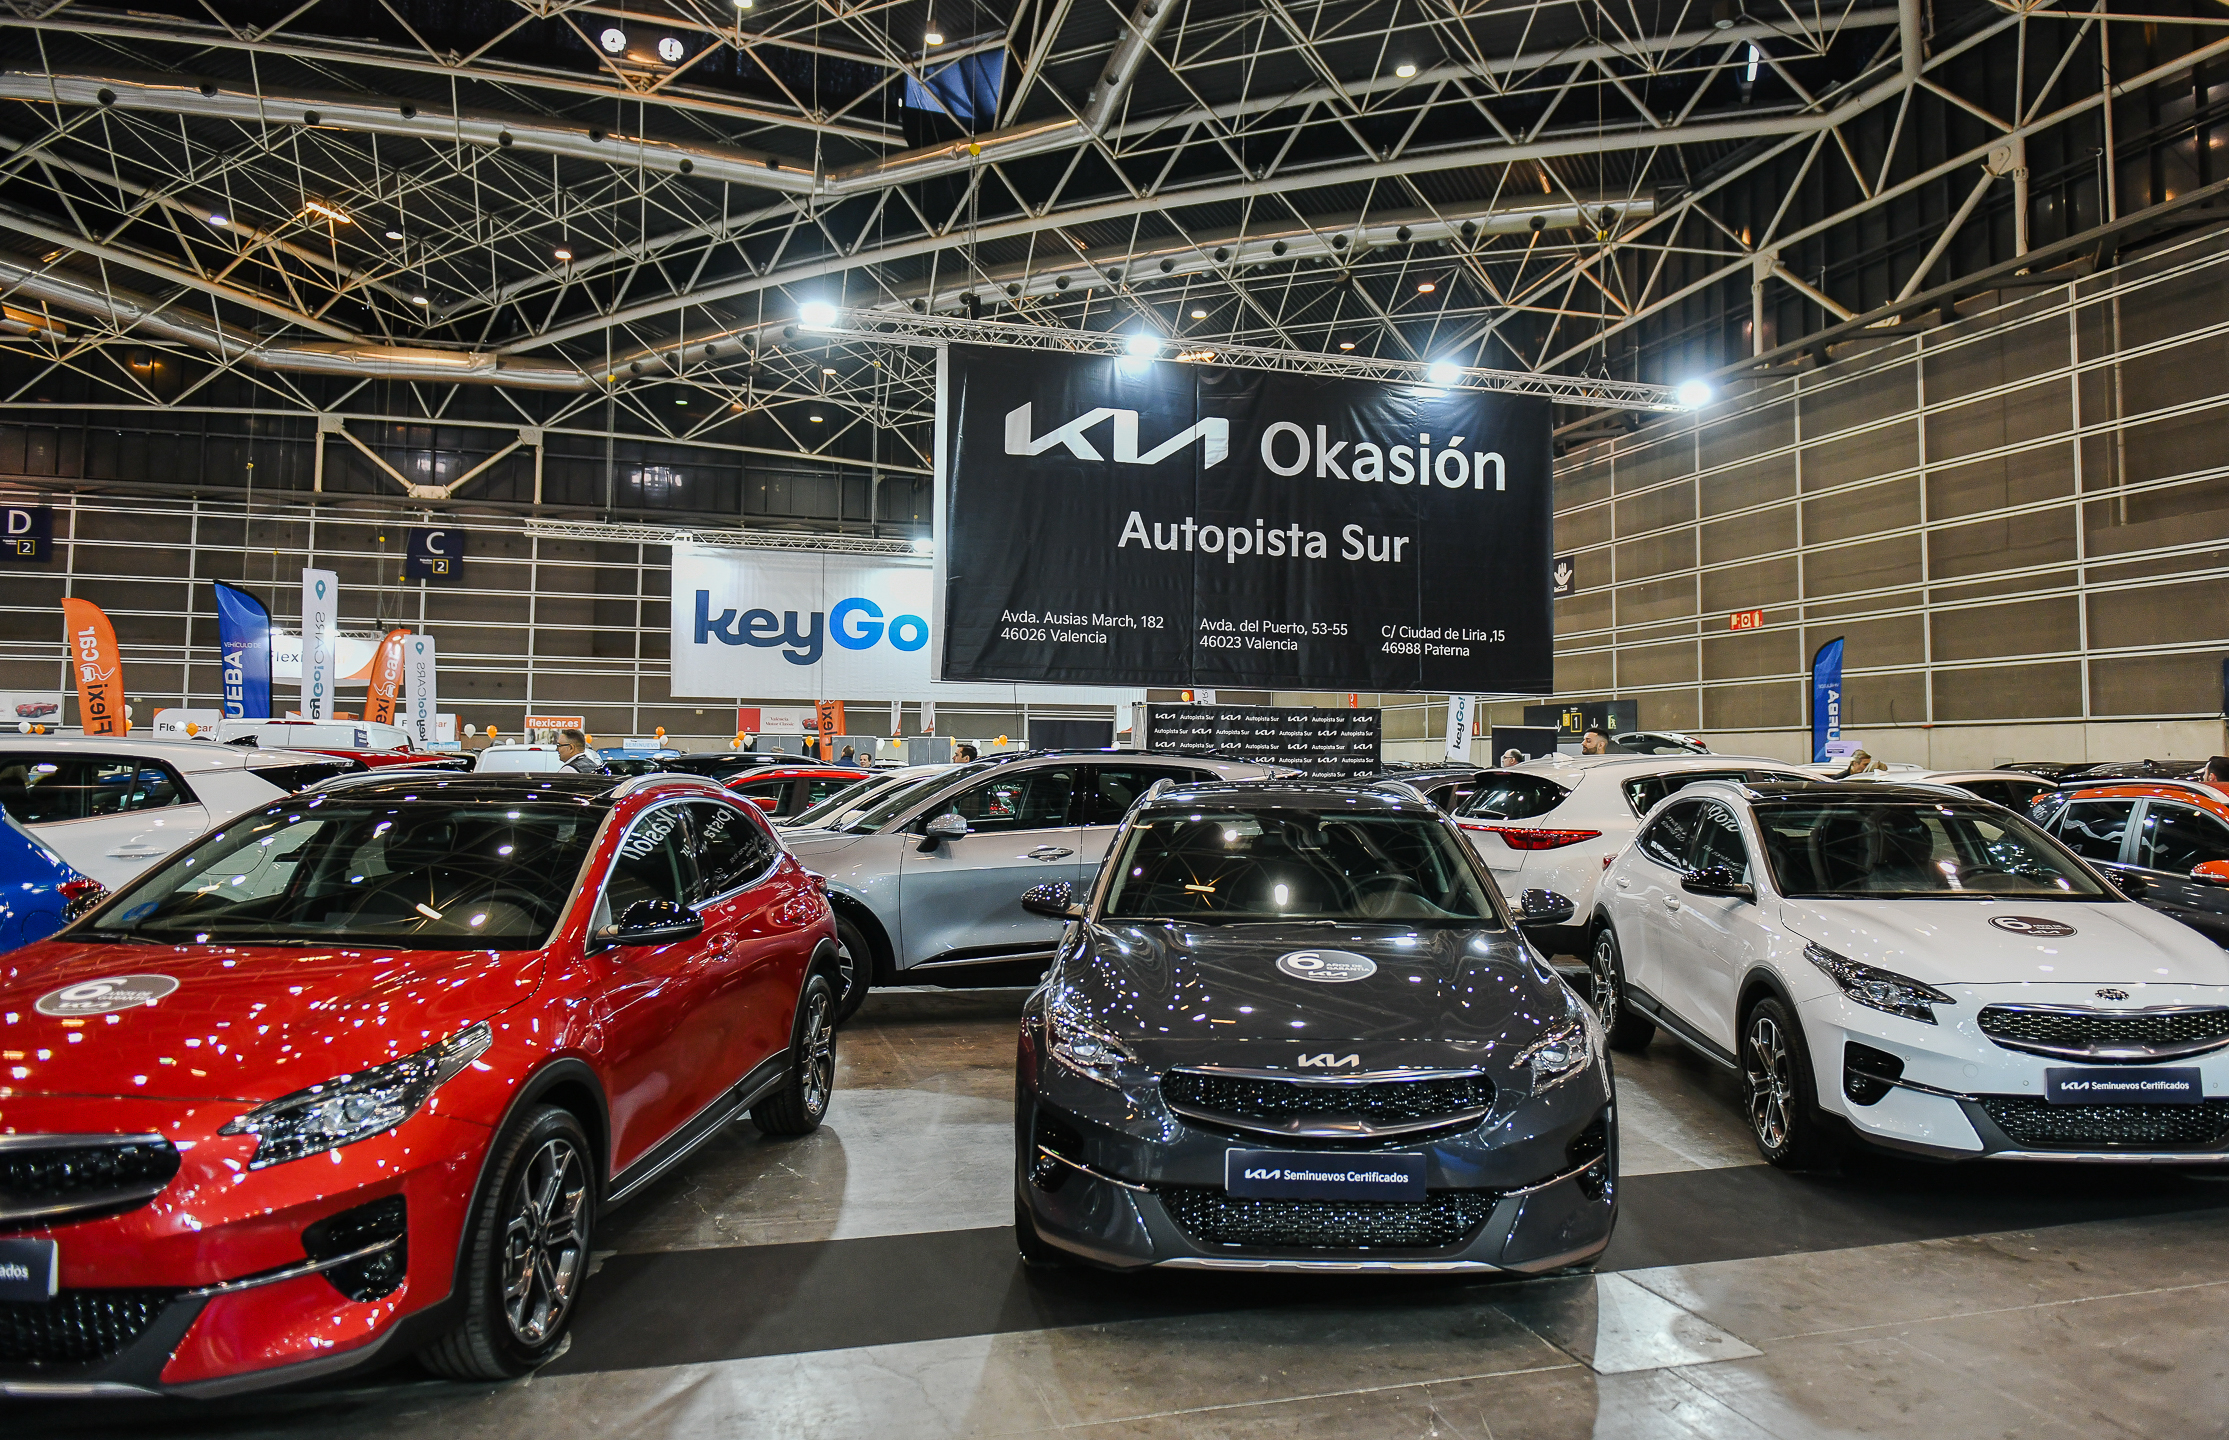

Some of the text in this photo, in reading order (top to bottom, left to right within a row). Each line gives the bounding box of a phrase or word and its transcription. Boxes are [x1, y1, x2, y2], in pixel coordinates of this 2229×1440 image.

[1261, 421, 1506, 490] Okasión
[8, 509, 32, 534] D
[426, 531, 445, 555] C
[1118, 511, 1409, 563] Autopista Sur
[22, 542, 31, 553] 2
[437, 561, 445, 572] 2
[694, 589, 930, 665] keyGo
[1001, 610, 1164, 629] Avda. Ausias March, 182
[1200, 618, 1348, 636] Avda. del Puerto, 53-55
[1001, 628, 1107, 644] 46026 Valencia
[1382, 625, 1396, 639] C/
[1400, 626, 1440, 640] Ciudad
[1444, 627, 1459, 640] de
[1463, 628, 1487, 641] Liria
[1200, 636, 1298, 651] 46023 Valencia
[1382, 642, 1470, 657] 46988 Paterna
[529, 717, 579, 729] flexicar.es
[1287, 953, 1325, 970] 6
[59, 978, 128, 1000] 6
[2091, 1081, 2139, 1090] Seminuevos
[2140, 1081, 2189, 1090] Certificados
[1283, 1169, 1345, 1182] Seminuevos
[1347, 1170, 1409, 1183] Certificados
